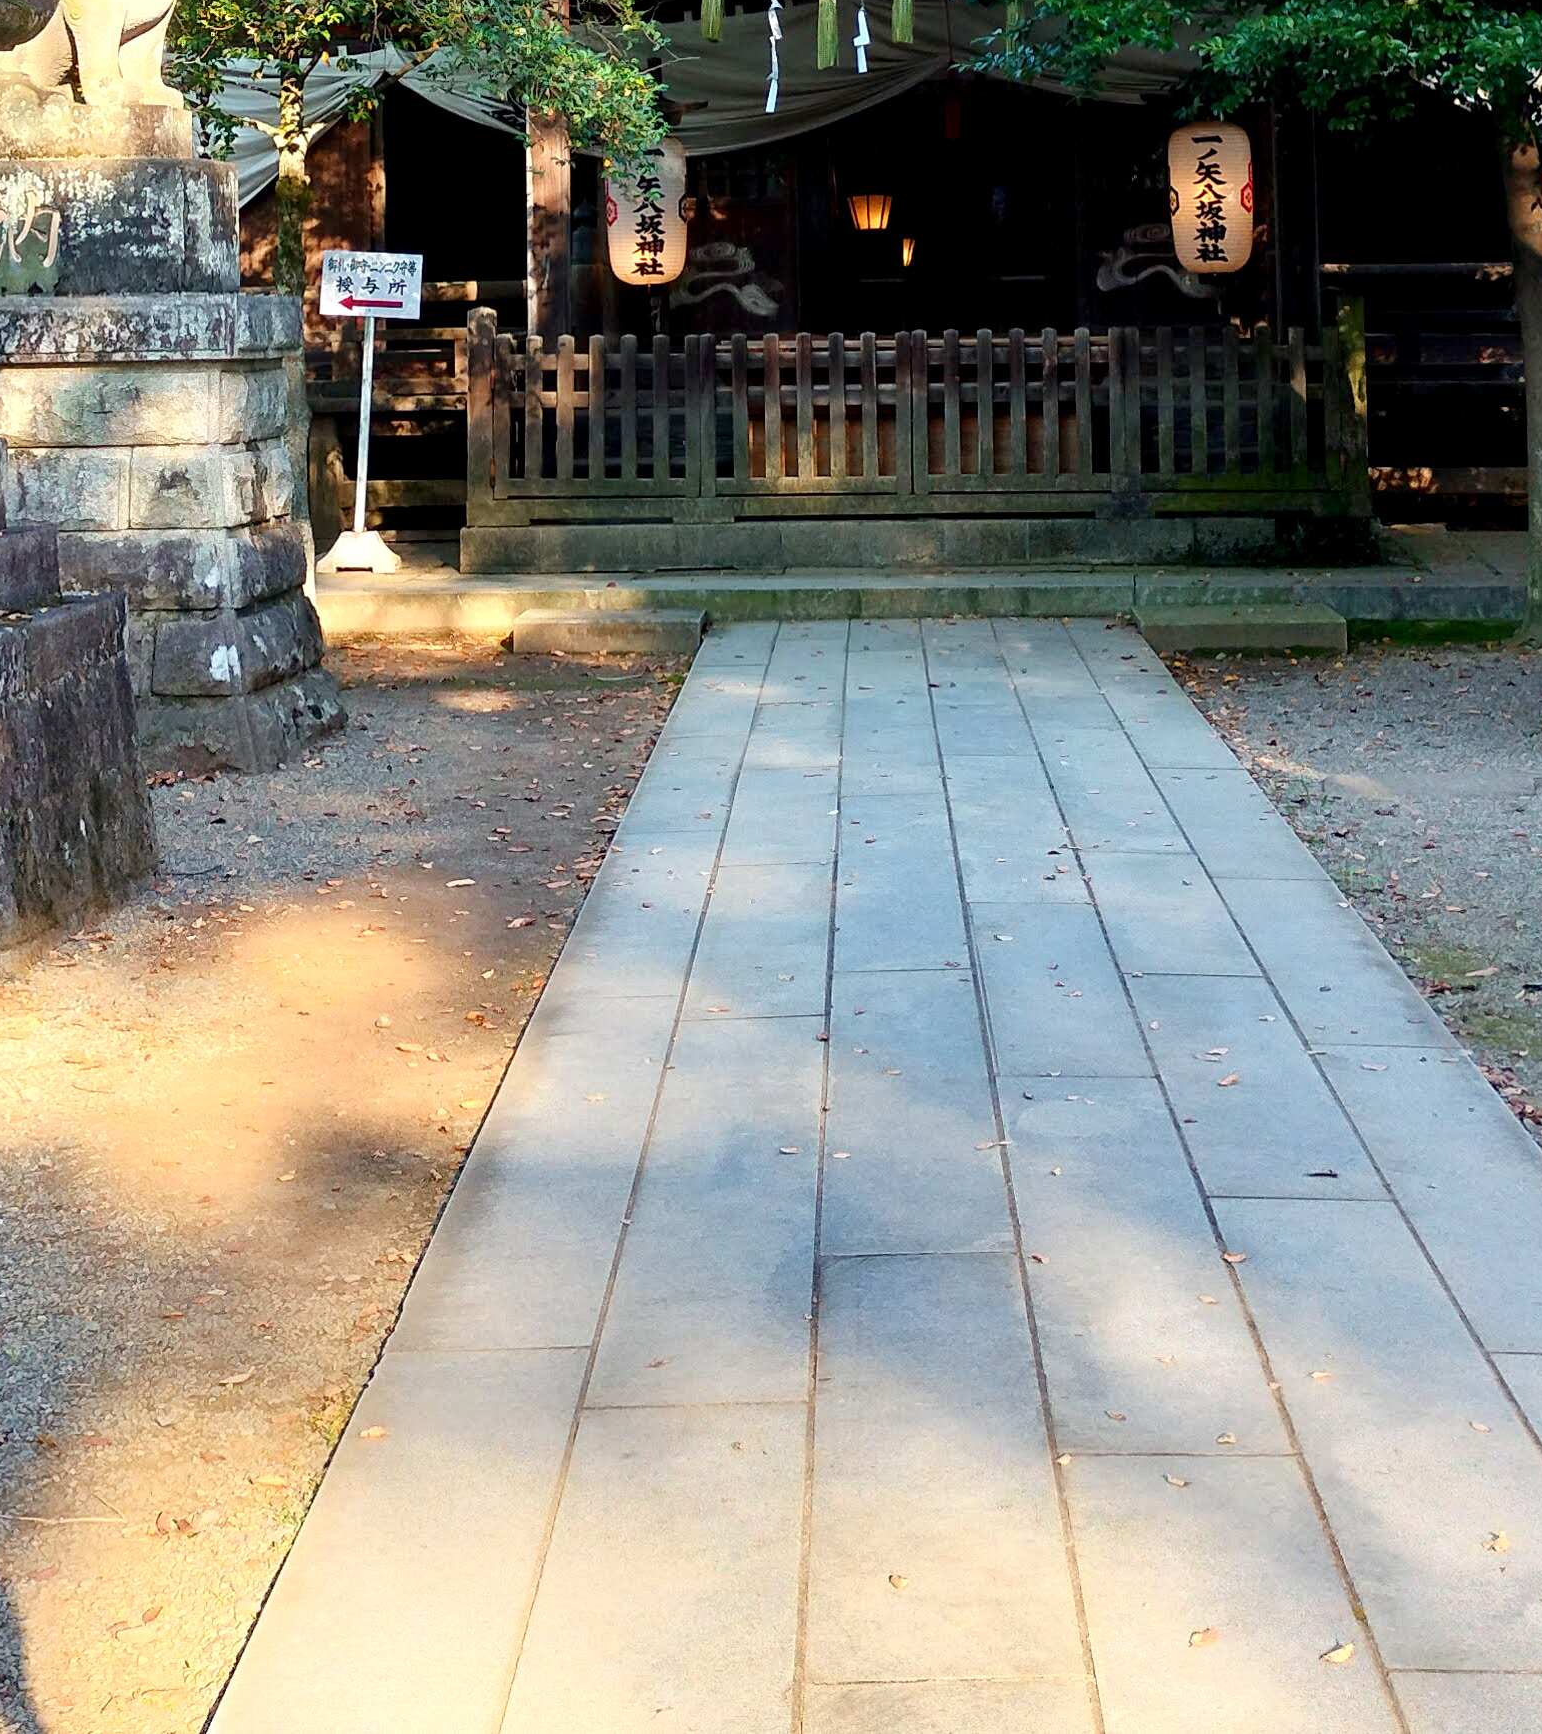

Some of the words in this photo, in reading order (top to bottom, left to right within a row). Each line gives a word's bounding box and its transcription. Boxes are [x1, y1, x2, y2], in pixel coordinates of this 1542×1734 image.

[1190, 134, 1229, 264] 一ノ矢八坂神社
[335, 275, 408, 296] 授与所
